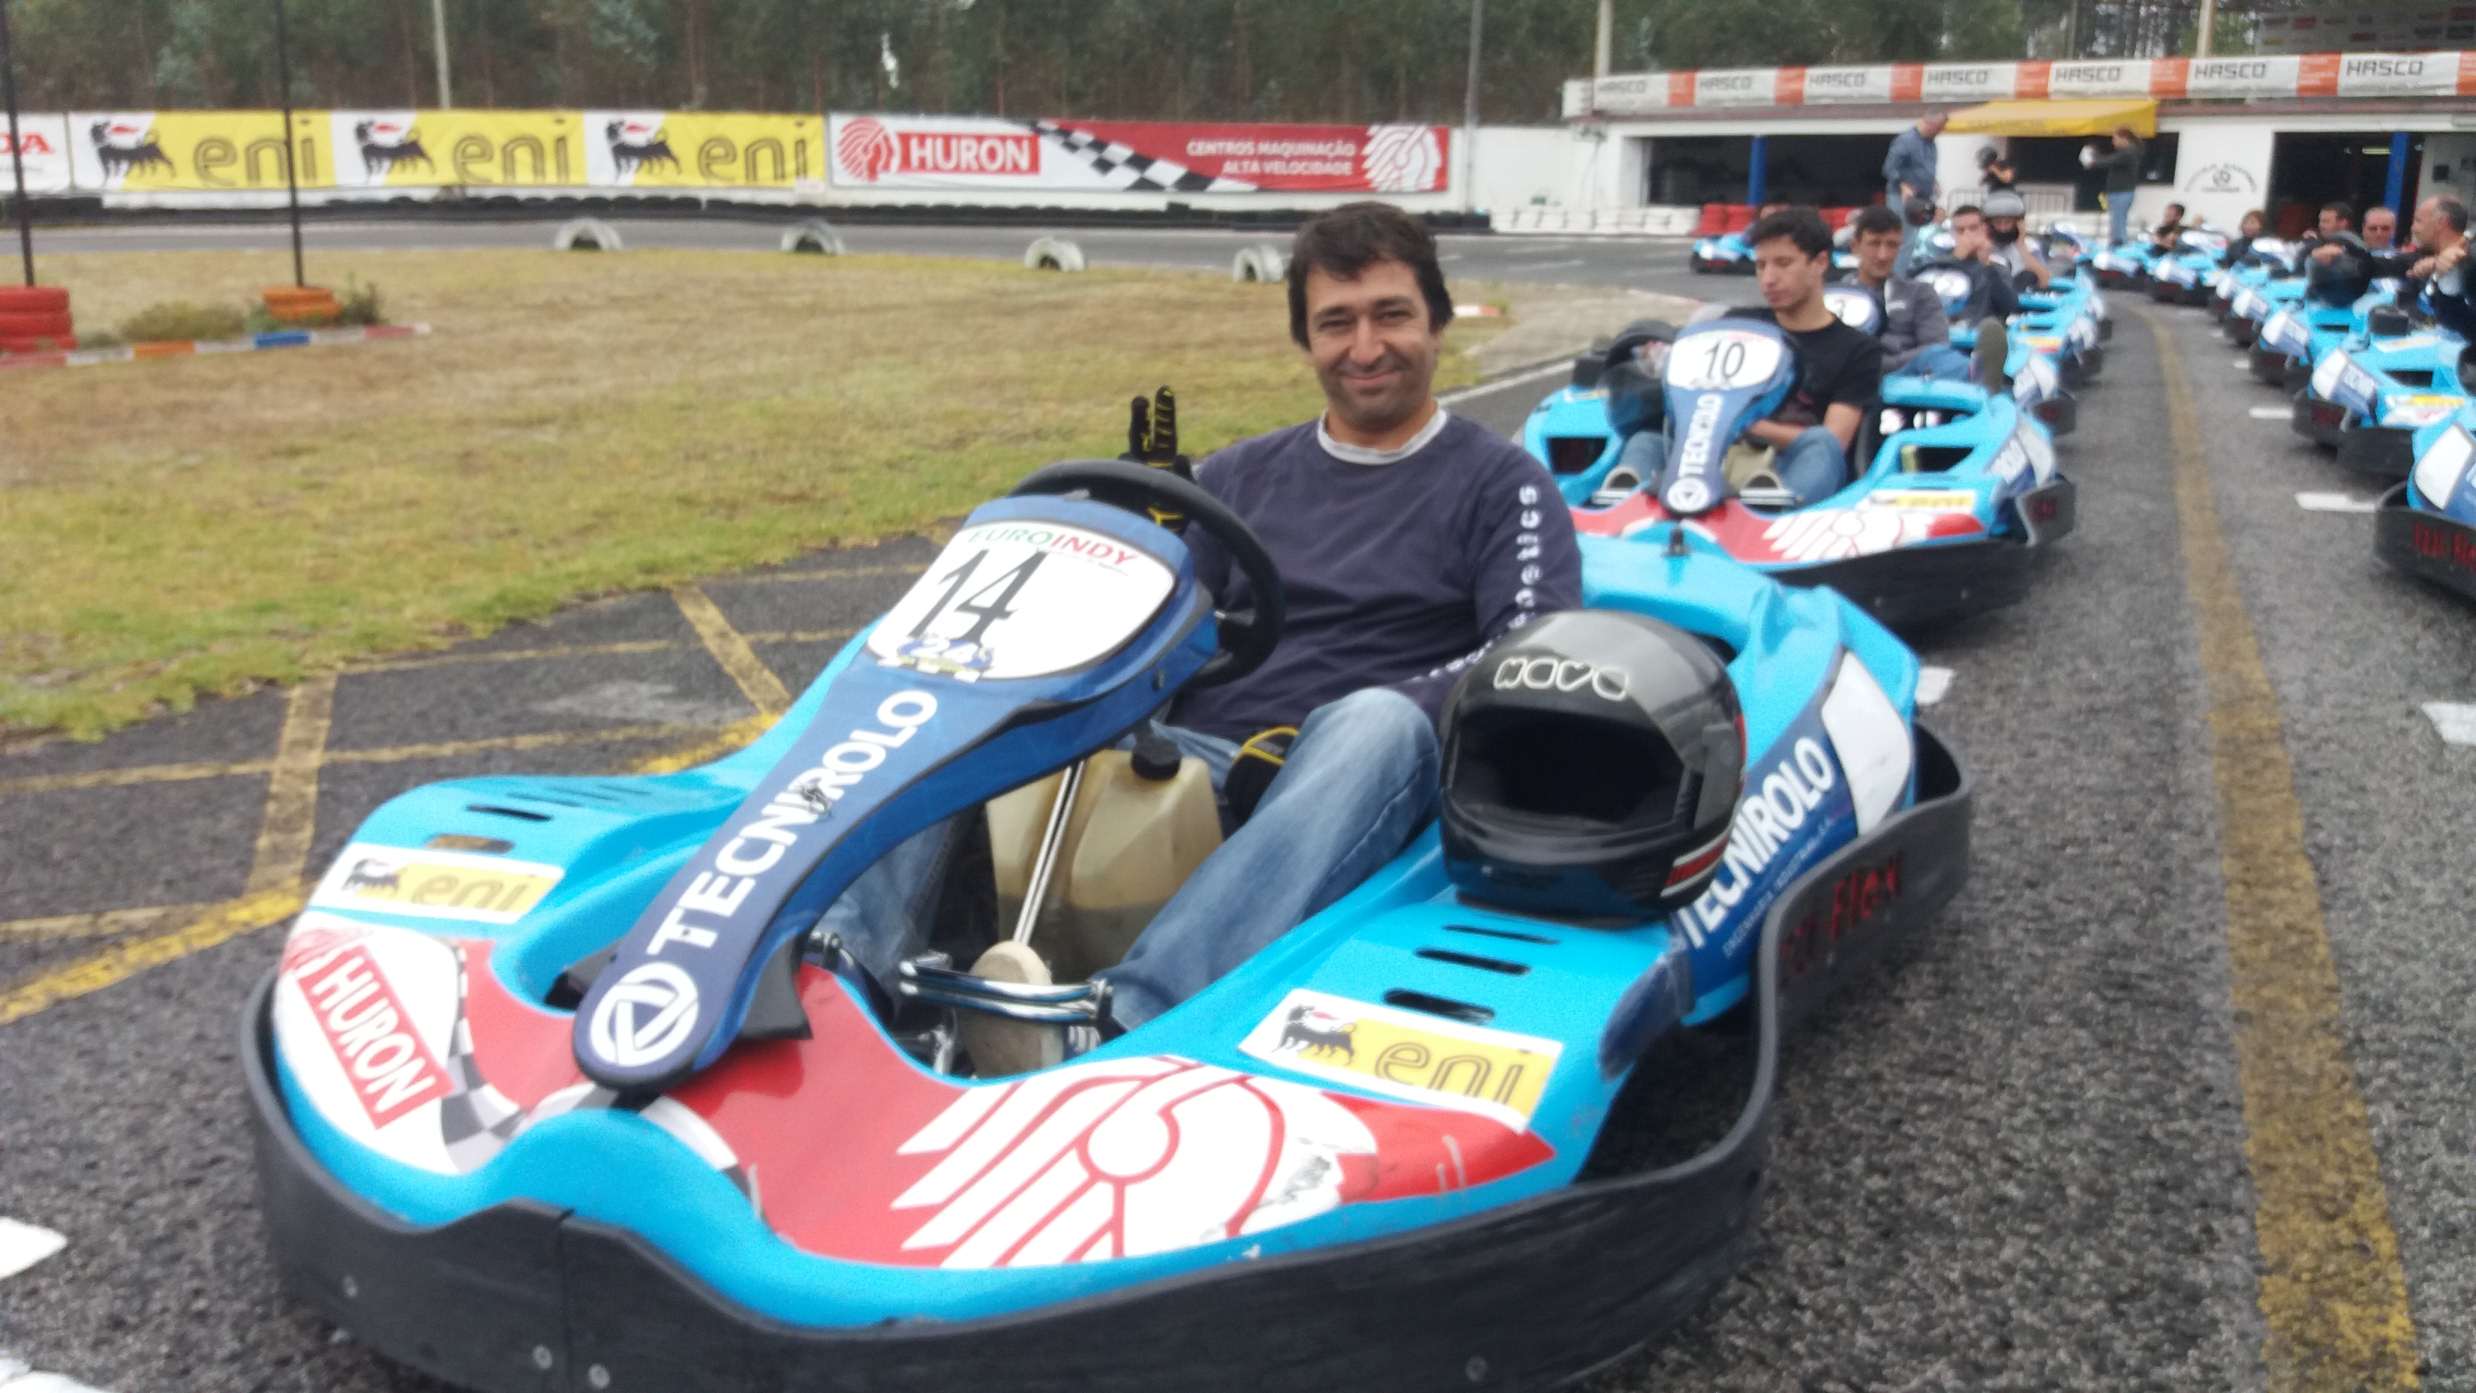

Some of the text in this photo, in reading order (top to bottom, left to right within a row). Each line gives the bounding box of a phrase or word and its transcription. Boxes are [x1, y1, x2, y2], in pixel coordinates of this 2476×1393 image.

[1809, 72, 1867, 88] HASCO
[1927, 69, 1990, 86] HASCO
[2055, 66, 2122, 83] HASCO
[2194, 63, 2267, 80] HASCO
[2346, 60, 2424, 76] HASCO
[193, 119, 316, 187] eni
[453, 119, 571, 186] eni
[697, 119, 808, 184] eni
[909, 136, 1030, 172] HURON
[1186, 139, 1356, 158] CENTROS MAQUINAÇÃO
[1223, 160, 1353, 176] ALTA VELOCIDADE
[1704, 340, 1746, 379] 10
[968, 527, 1138, 568] EUROINDY
[906, 548, 1049, 648] 14
[646, 689, 938, 955] TECNIROLO
[410, 872, 538, 912] eni
[311, 955, 437, 1114] HURON
[1374, 1041, 1533, 1105] eni
